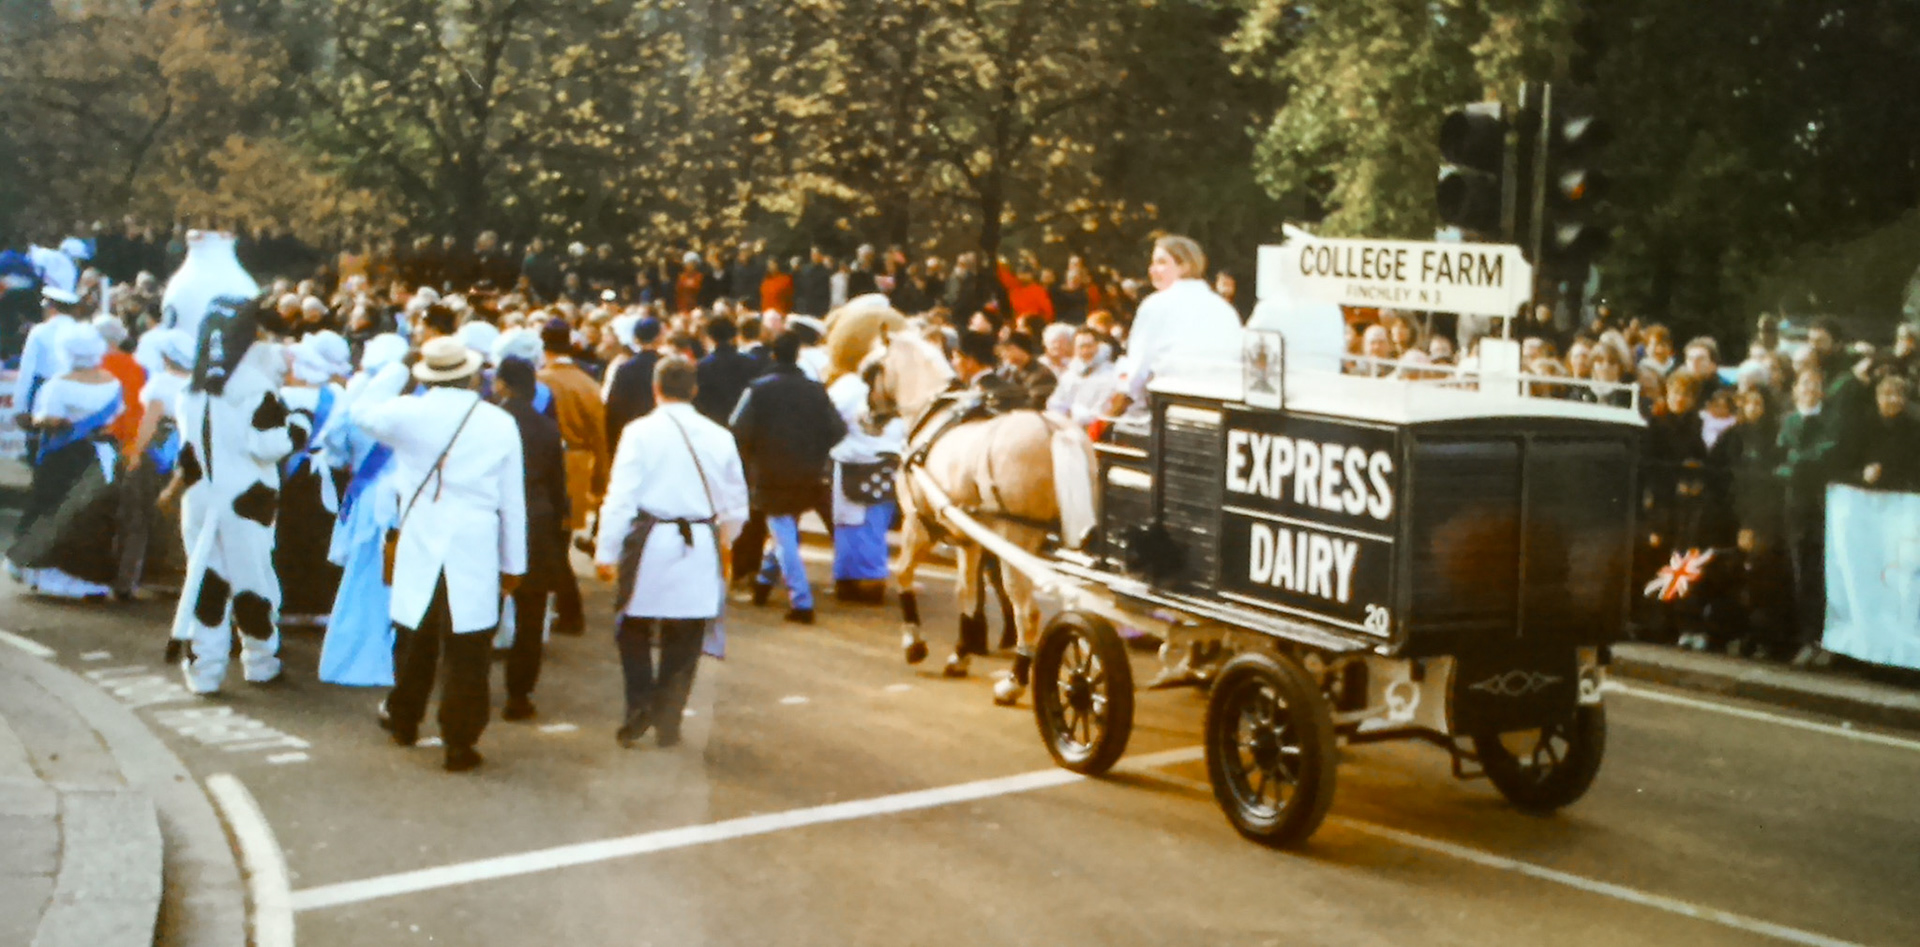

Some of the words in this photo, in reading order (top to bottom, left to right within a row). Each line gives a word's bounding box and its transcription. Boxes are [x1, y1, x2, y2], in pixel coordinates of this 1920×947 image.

[1300, 245, 1408, 282] COLLEGE
[1420, 250, 1504, 288] FARM
[1346, 284, 1411, 303] FINCHLEY
[1226, 429, 1393, 521] EXPRESS
[1248, 522, 1360, 604] DAIRY
[1364, 604, 1390, 633] 20
